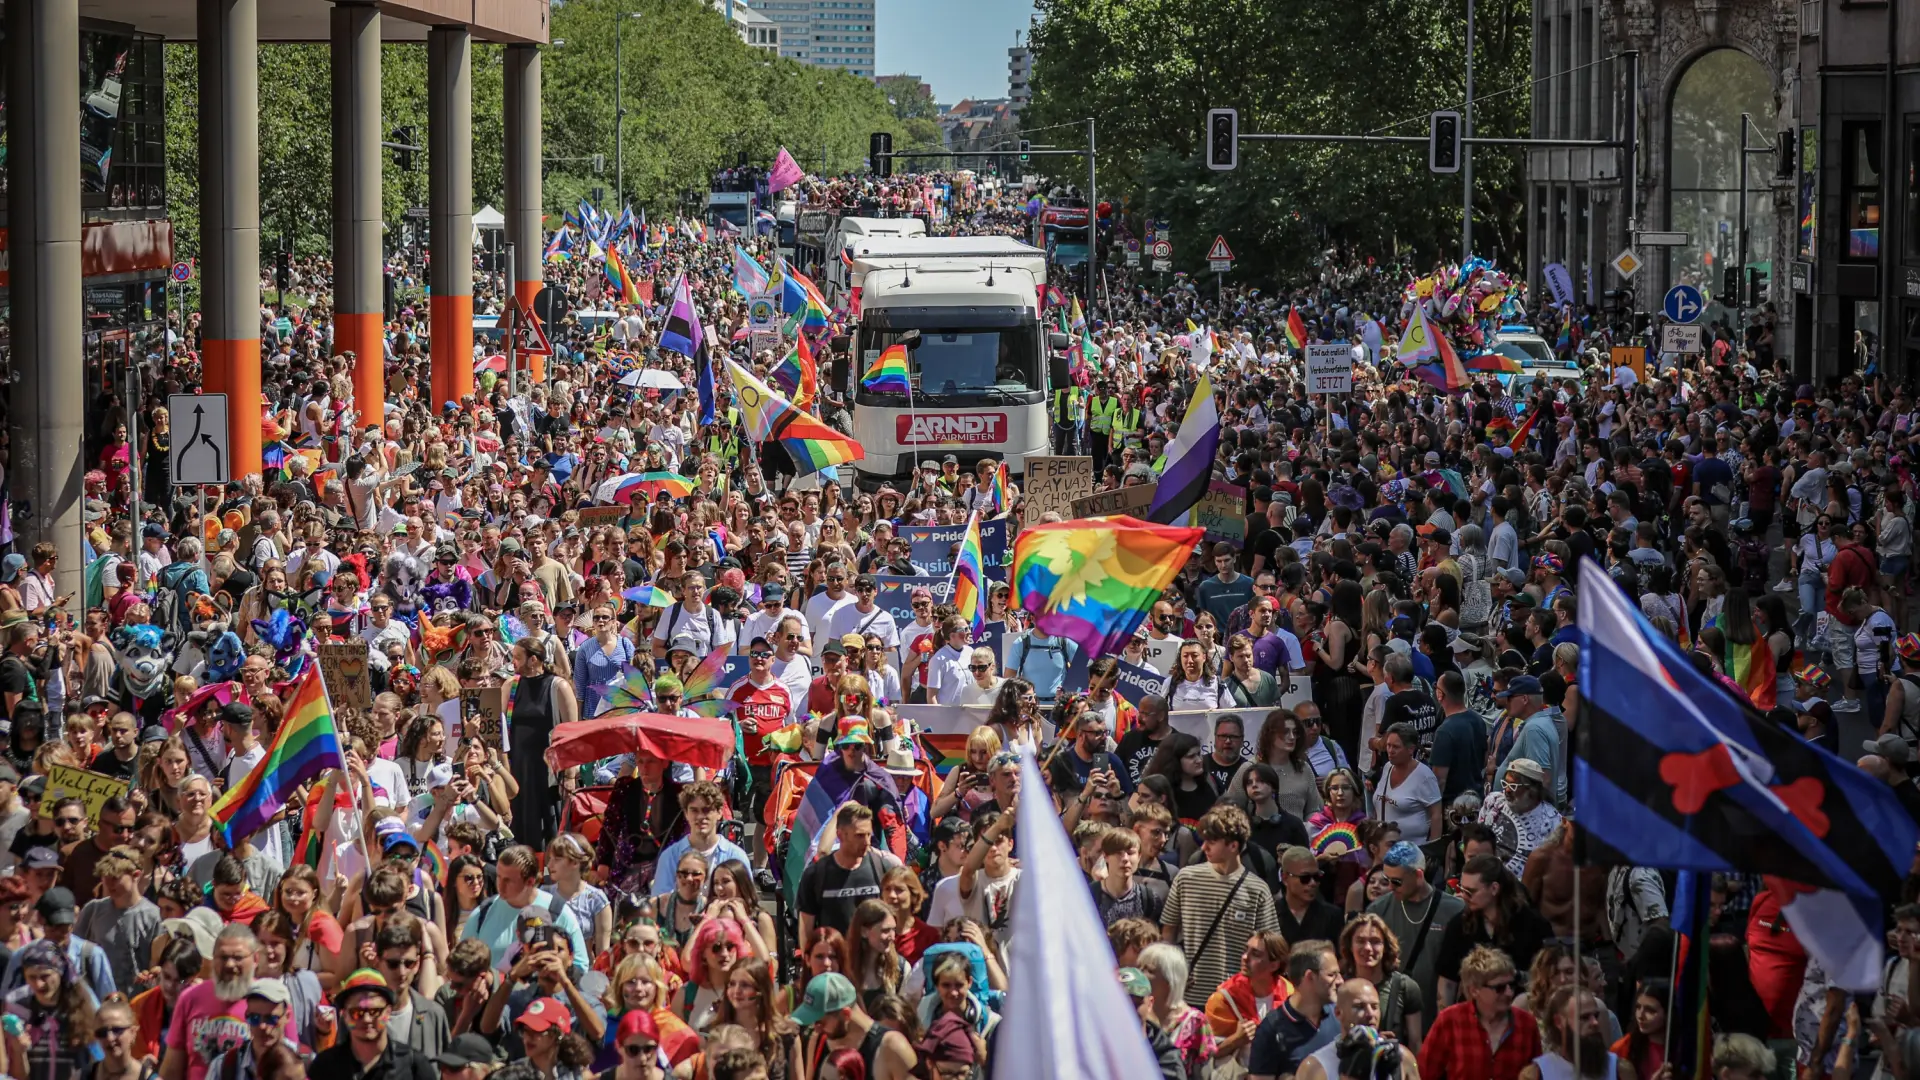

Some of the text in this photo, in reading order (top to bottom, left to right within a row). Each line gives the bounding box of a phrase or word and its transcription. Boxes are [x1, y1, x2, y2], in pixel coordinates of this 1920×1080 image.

[1157, 246, 1167, 255] 30
[1792, 276, 1806, 290] TEMPUR
[1316, 376, 1345, 389] JETZT
[904, 416, 1001, 441] ARNDT
[935, 433, 995, 441] FAIRMIETEN
[1028, 460, 1089, 478] IF BEING
[1028, 478, 1062, 495] GAY
[1024, 490, 1089, 509] A CHOICE
[1025, 507, 1040, 523] I'D
[745, 705, 781, 718] BERLIN
[1129, 758, 1140, 778] BAD
[52, 768, 121, 798] Vielfalt
